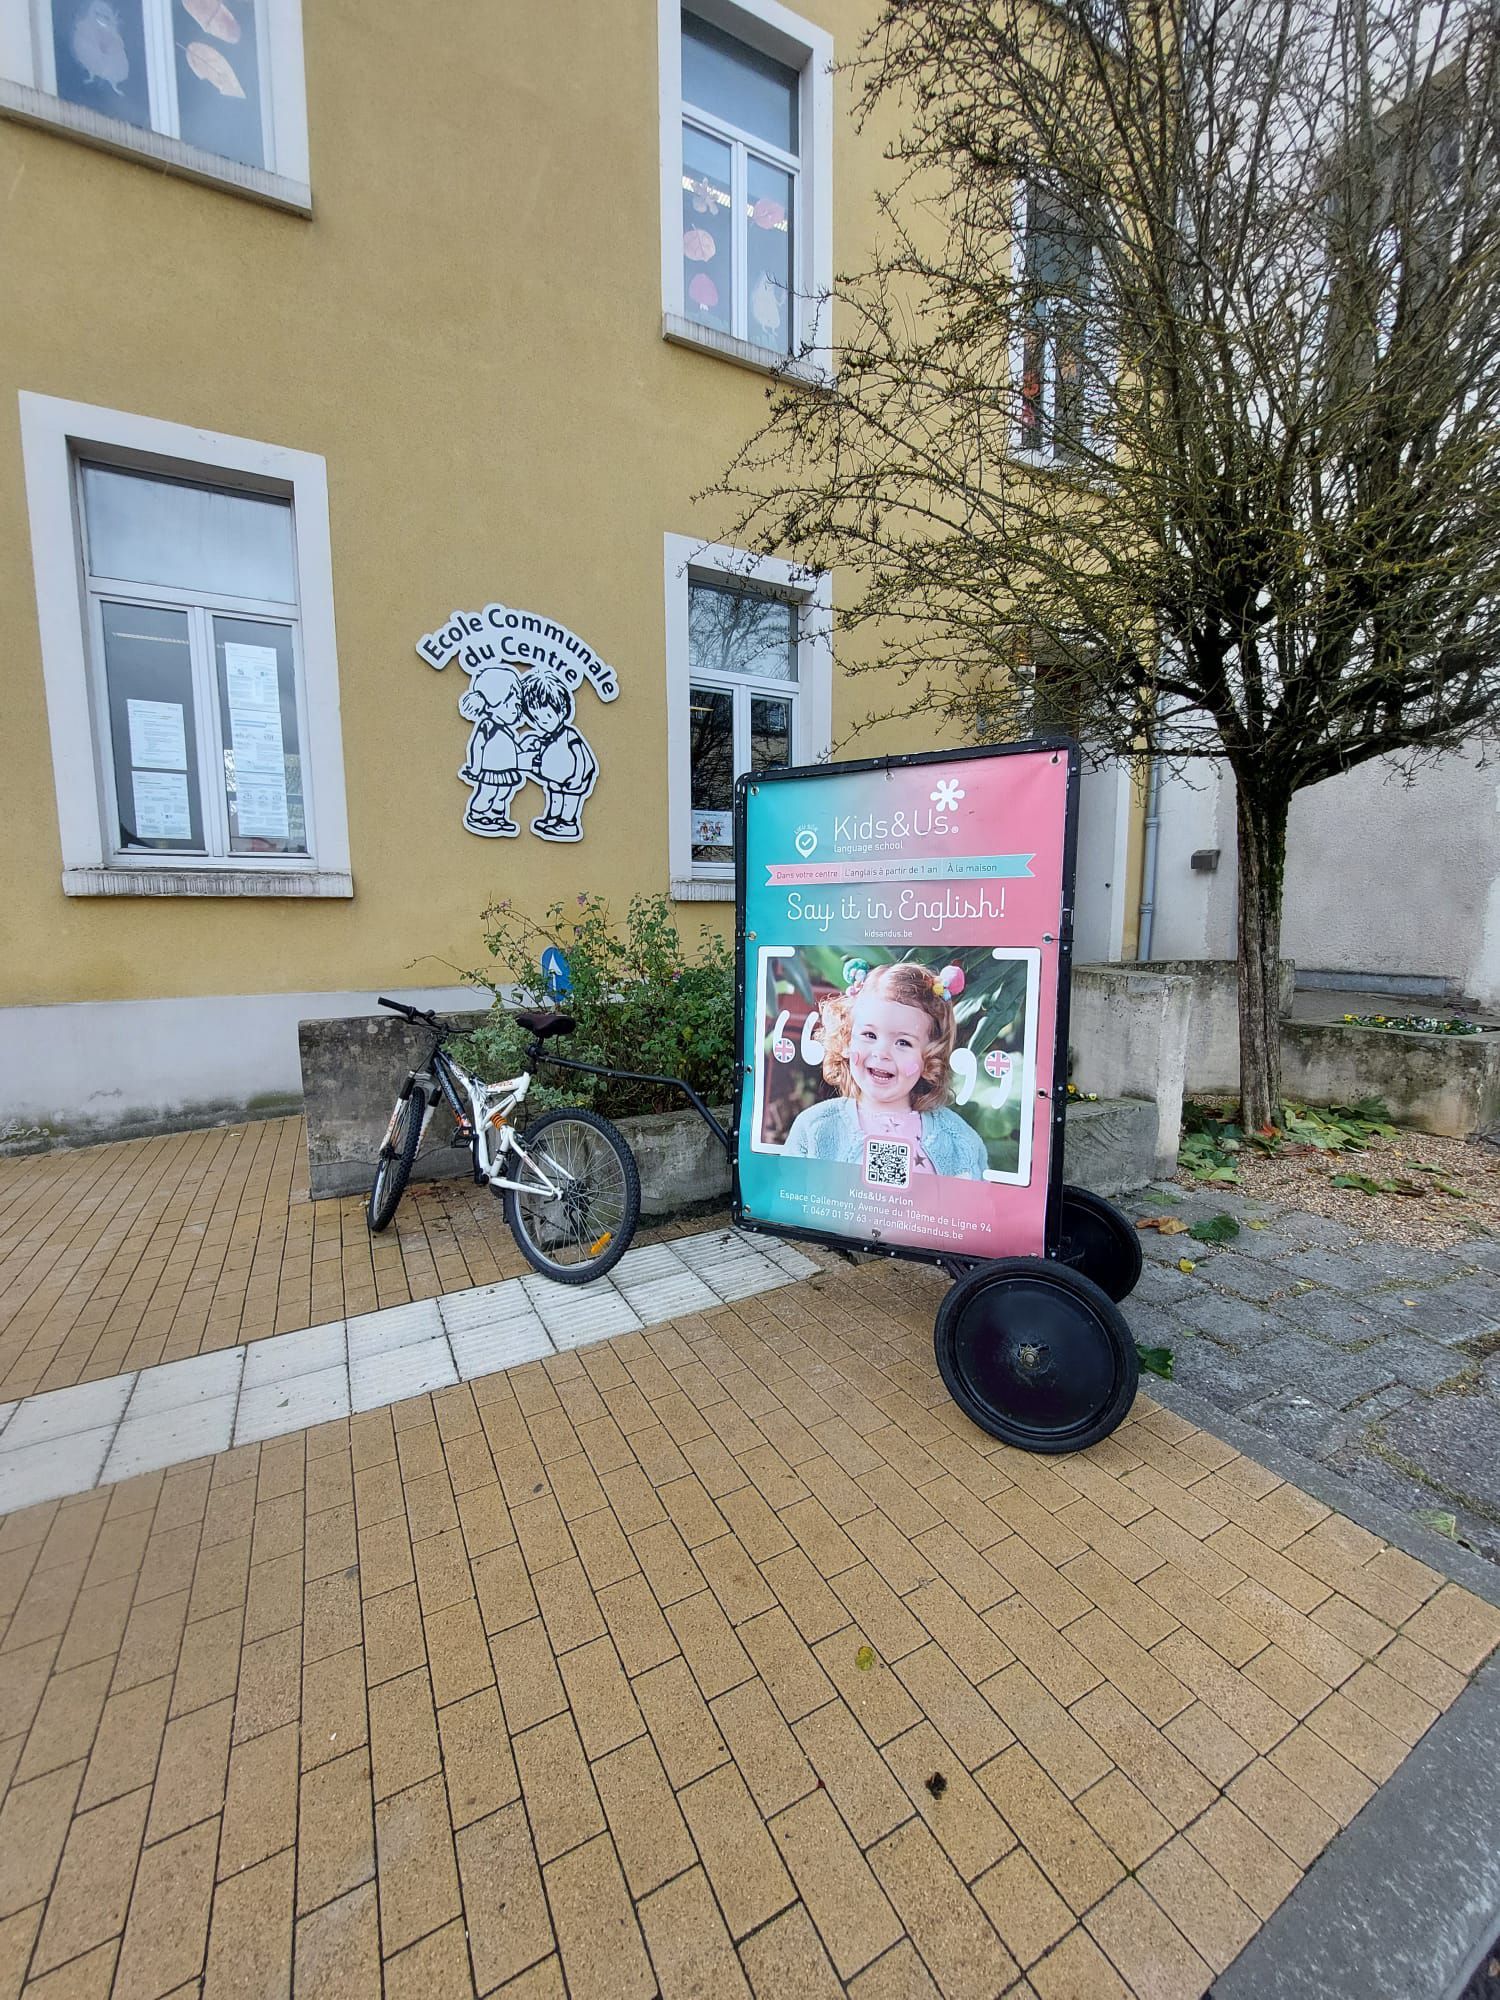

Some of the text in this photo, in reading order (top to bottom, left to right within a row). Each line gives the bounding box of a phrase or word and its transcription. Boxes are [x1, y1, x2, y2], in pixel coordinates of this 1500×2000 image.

[423, 608, 614, 695] Ecole Communale
[465, 636, 577, 683] du Centre
[834, 840, 903, 855] language school
[776, 871, 794, 880] Dans
[796, 870, 813, 879] votre
[815, 870, 838, 878] centre
[845, 868, 878, 878] L'anglais
[885, 866, 906, 877] partir
[909, 865, 919, 874] de
[955, 864, 964, 873] la
[965, 863, 997, 873] maison
[787, 887, 1005, 932] Say it in English!
[864, 929, 912, 938] kidsandus.be
[780, 1189, 808, 1202] Espace
[858, 1202, 889, 1215] Avenue
[892, 1208, 902, 1217] du
[906, 1209, 935, 1223] 10ème
[937, 1215, 949, 1225] de
[951, 1217, 977, 1231] Ligne
[980, 1222, 991, 1233] 94
[849, 1188, 914, 1206] Kids&Us Arlon
[802, 1204, 809, 1214] T.
[810, 1206, 830, 1217] 0467
[832, 1209, 841, 1219] 01
[844, 1211, 854, 1221] 57
[856, 1214, 866, 1223] 63
[873, 1216, 963, 1239] arlon@kidsandus.be
